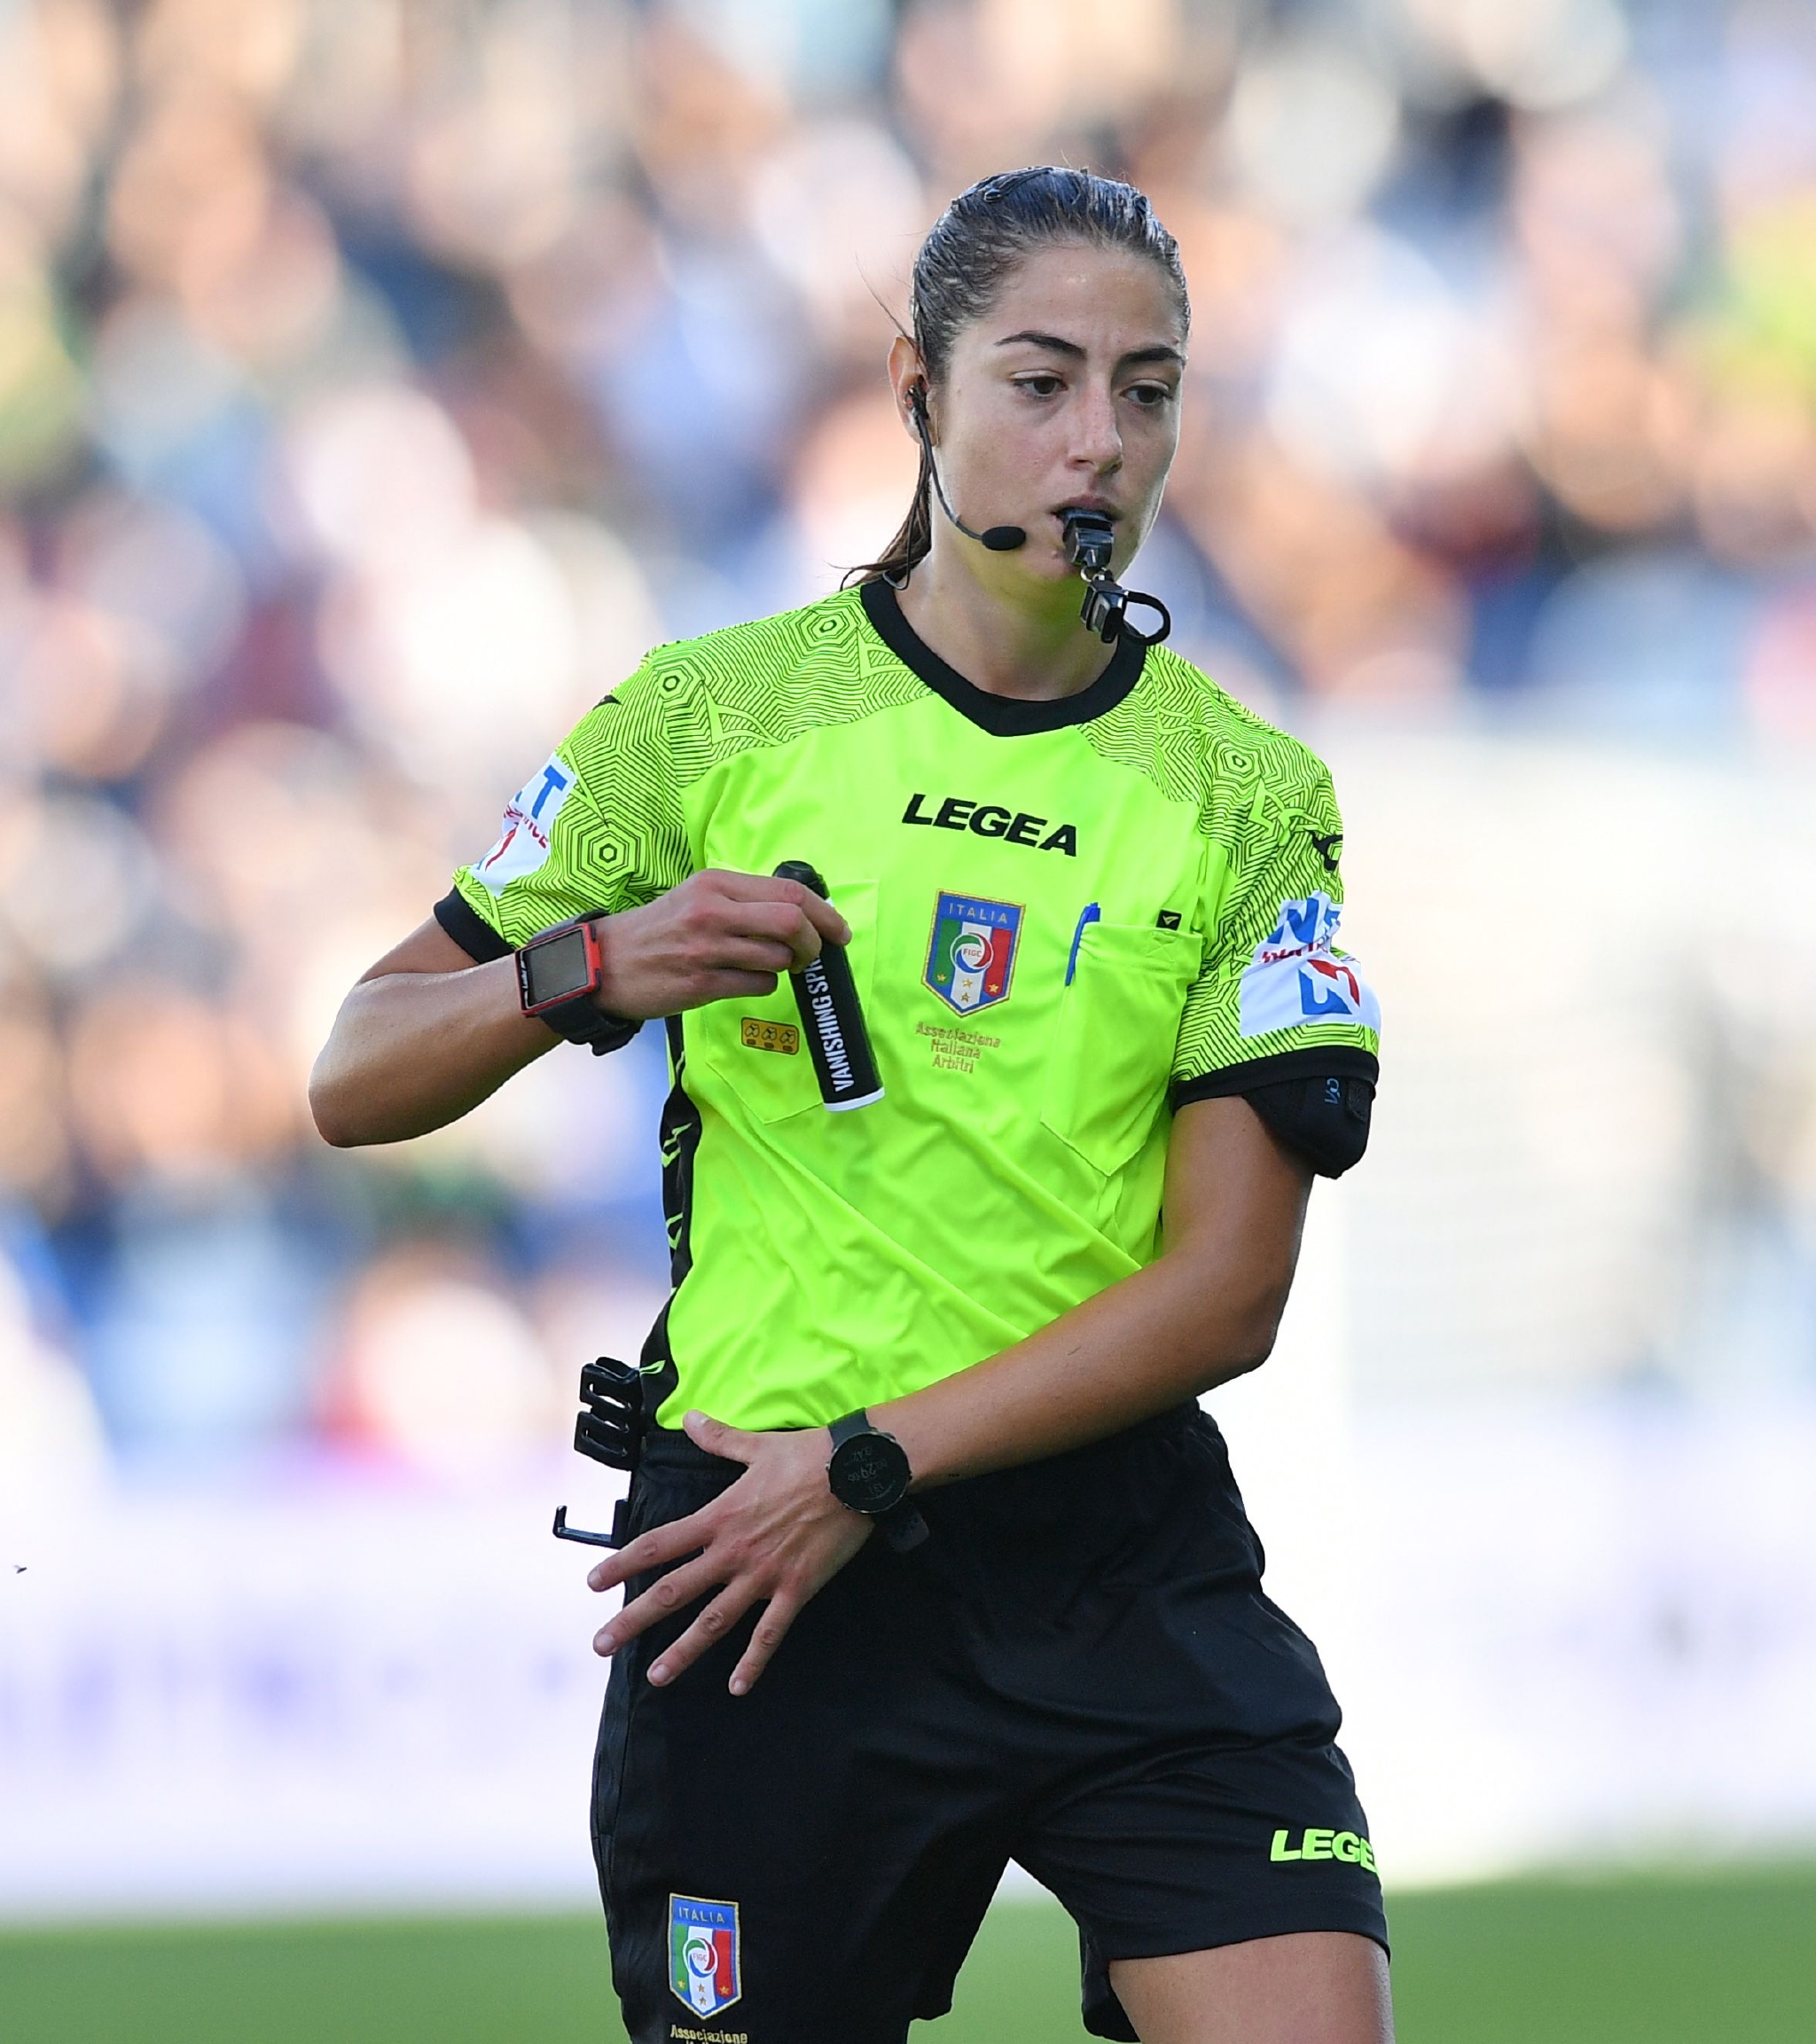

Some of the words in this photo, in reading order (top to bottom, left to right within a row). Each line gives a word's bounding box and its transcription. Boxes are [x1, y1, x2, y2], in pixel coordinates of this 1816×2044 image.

[902, 793, 1076, 858] LEGEA
[949, 902, 1008, 924] ITALIA
[962, 948, 982, 958] FIGC
[811, 994, 855, 1092] VANISHING
[915, 1021, 1001, 1048] Associazione
[930, 1038, 981, 1060] Italiana
[932, 1053, 975, 1074] Arbitri
[1270, 1828, 1378, 1873] LEGE
[678, 1906, 725, 1924] ITALIA
[693, 1952, 708, 1963] FIGC
[669, 2024, 748, 2044] Associazione
